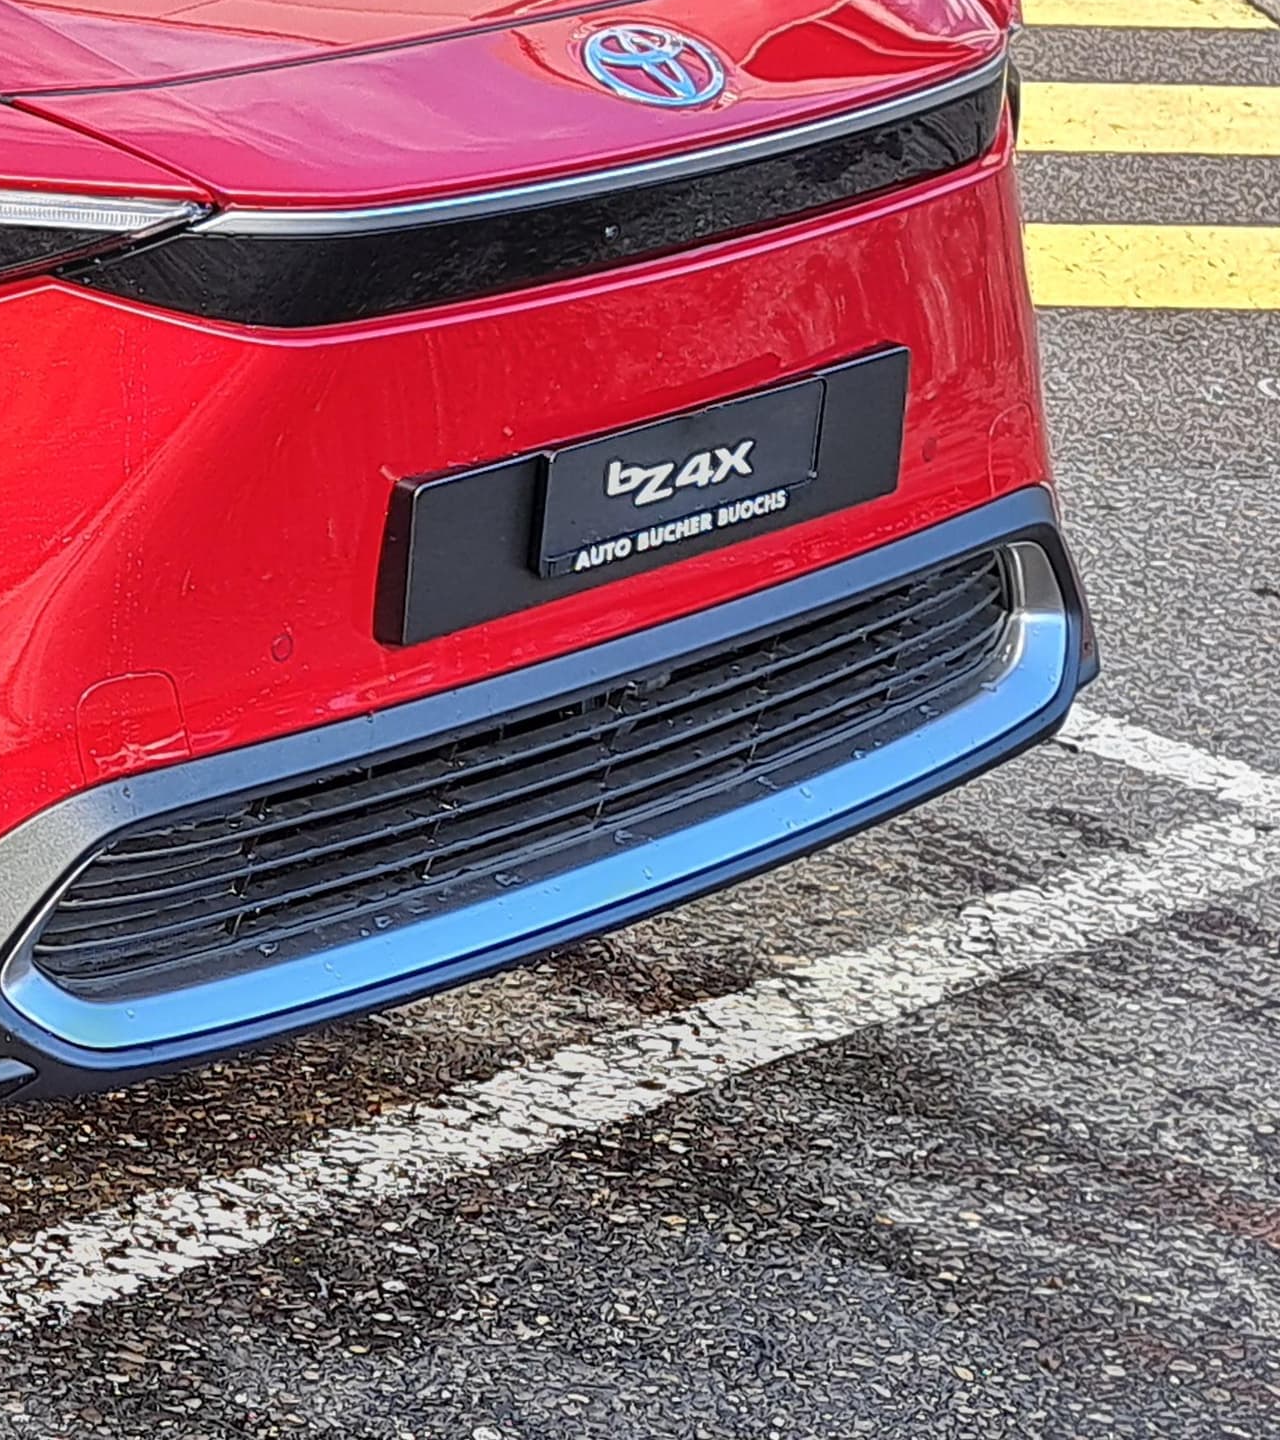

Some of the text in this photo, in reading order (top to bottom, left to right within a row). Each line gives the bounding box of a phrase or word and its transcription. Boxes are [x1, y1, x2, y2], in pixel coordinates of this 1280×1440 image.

[573, 489, 787, 571] AUTO BUCHER BUOCHS
